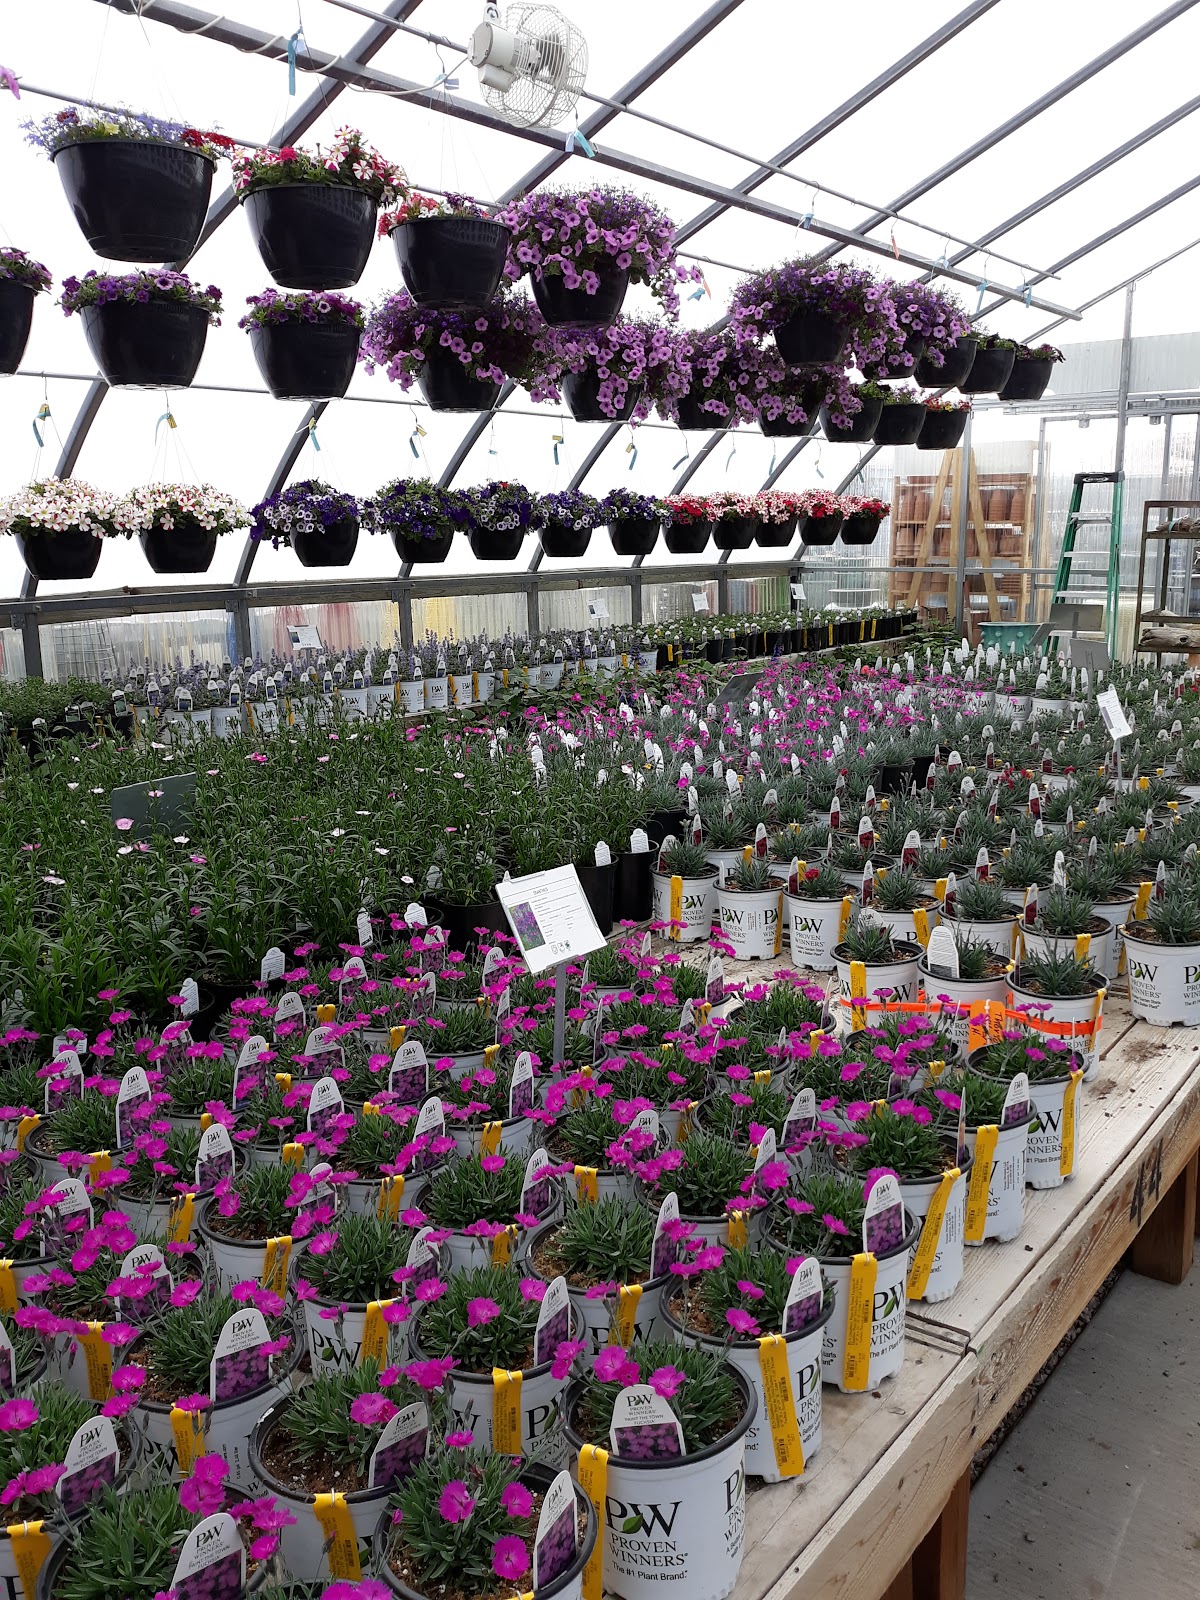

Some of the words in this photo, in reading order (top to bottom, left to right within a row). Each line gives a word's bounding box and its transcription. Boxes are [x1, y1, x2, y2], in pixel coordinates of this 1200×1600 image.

[431, 684, 444, 693] PW
[681, 894, 706, 909] PW
[721, 906, 745, 925] PW
[794, 915, 824, 934] PW
[796, 932, 820, 940] PROVEN
[1129, 958, 1159, 982] PW
[1184, 965, 1200, 984] P
[248, 1041, 262, 1052] PW
[402, 1047, 417, 1057] PW
[518, 1059, 528, 1070] PW
[127, 1072, 142, 1085] PW
[1014, 1080, 1026, 1090] PW
[318, 1083, 332, 1096] PW
[798, 1094, 812, 1105] PW
[425, 1103, 437, 1116] PW
[638, 1116, 654, 1126] PW
[1036, 1108, 1064, 1134] W
[207, 1130, 222, 1144] PW
[532, 1156, 544, 1169] PW
[876, 1182, 892, 1197] PW
[800, 1265, 814, 1282] PW
[232, 1316, 255, 1334] PW
[310, 1325, 362, 1367] PW
[626, 1394, 653, 1407] PW
[396, 1408, 420, 1427] PW
[80, 1424, 104, 1448] PW
[722, 1458, 744, 1515] P
[605, 1496, 682, 1538] PW
[196, 1522, 224, 1550] PW
[611, 1532, 676, 1553] PROVEN
[608, 1542, 688, 1566] WINNERS
[612, 1560, 624, 1574] The
[626, 1568, 634, 1577] #1
[638, 1570, 658, 1580] Plant
